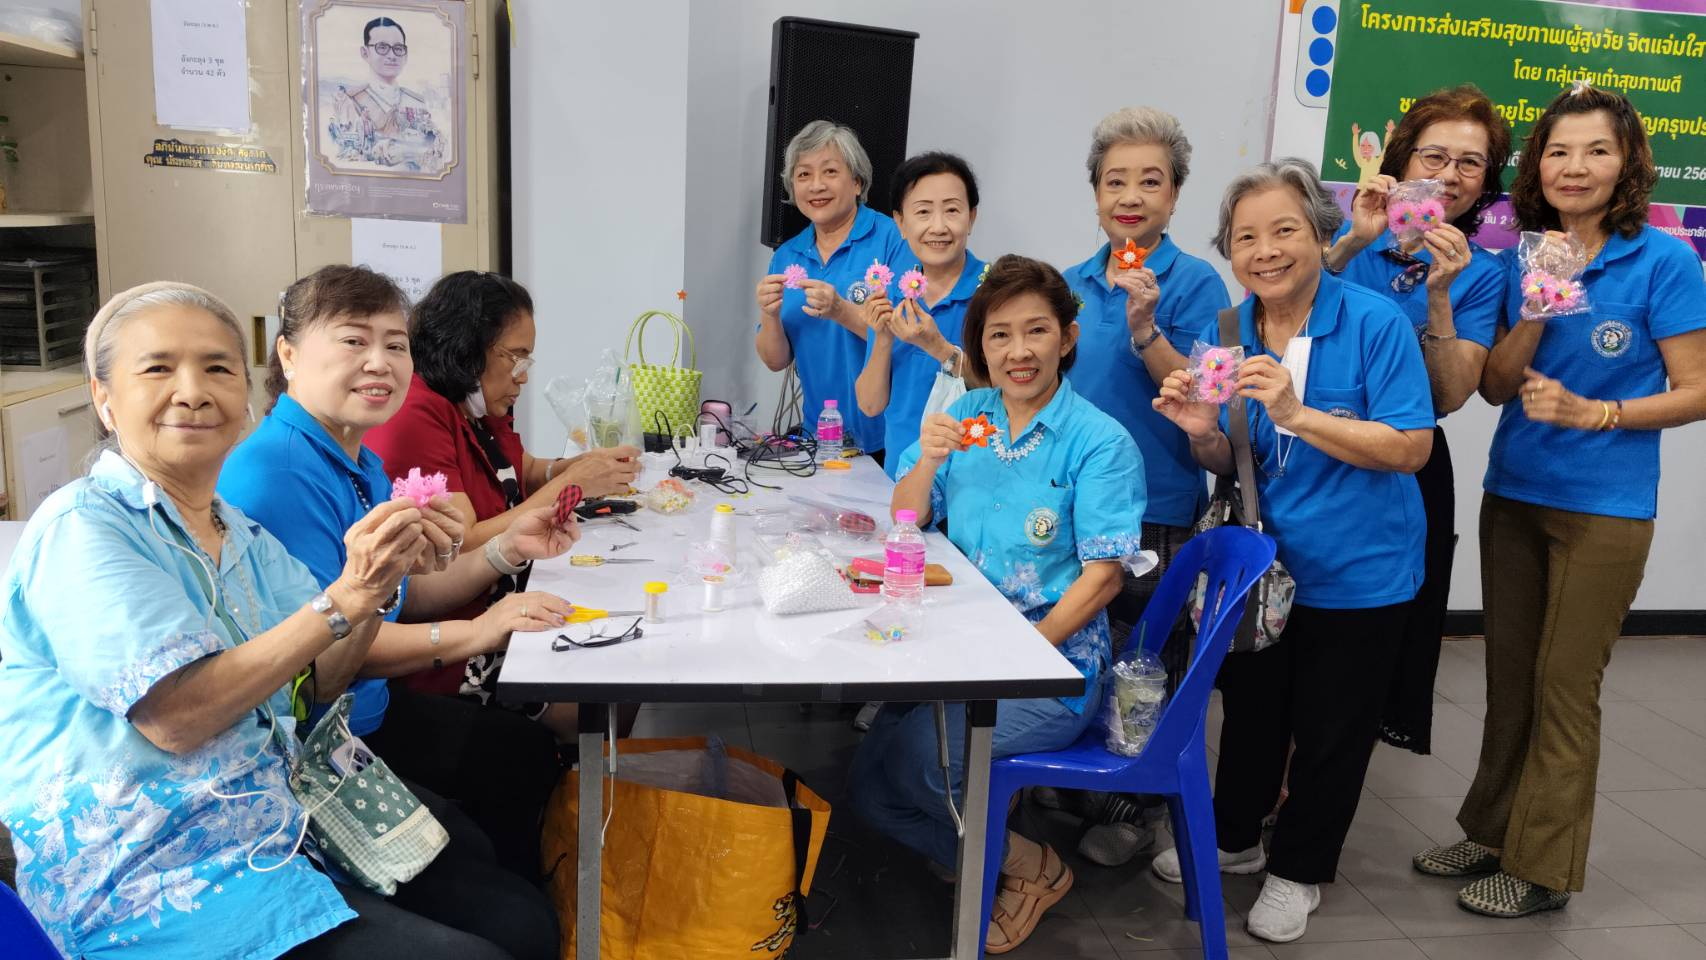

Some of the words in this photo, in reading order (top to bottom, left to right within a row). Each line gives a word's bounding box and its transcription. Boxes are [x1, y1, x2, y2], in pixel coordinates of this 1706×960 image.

[1361, 3, 1624, 54] โครงการส่งเสริมสุขภาพผู้สูงวัย
[1627, 31, 1706, 57] จิตแจ่มใส
[1513, 58, 1542, 81] โดย
